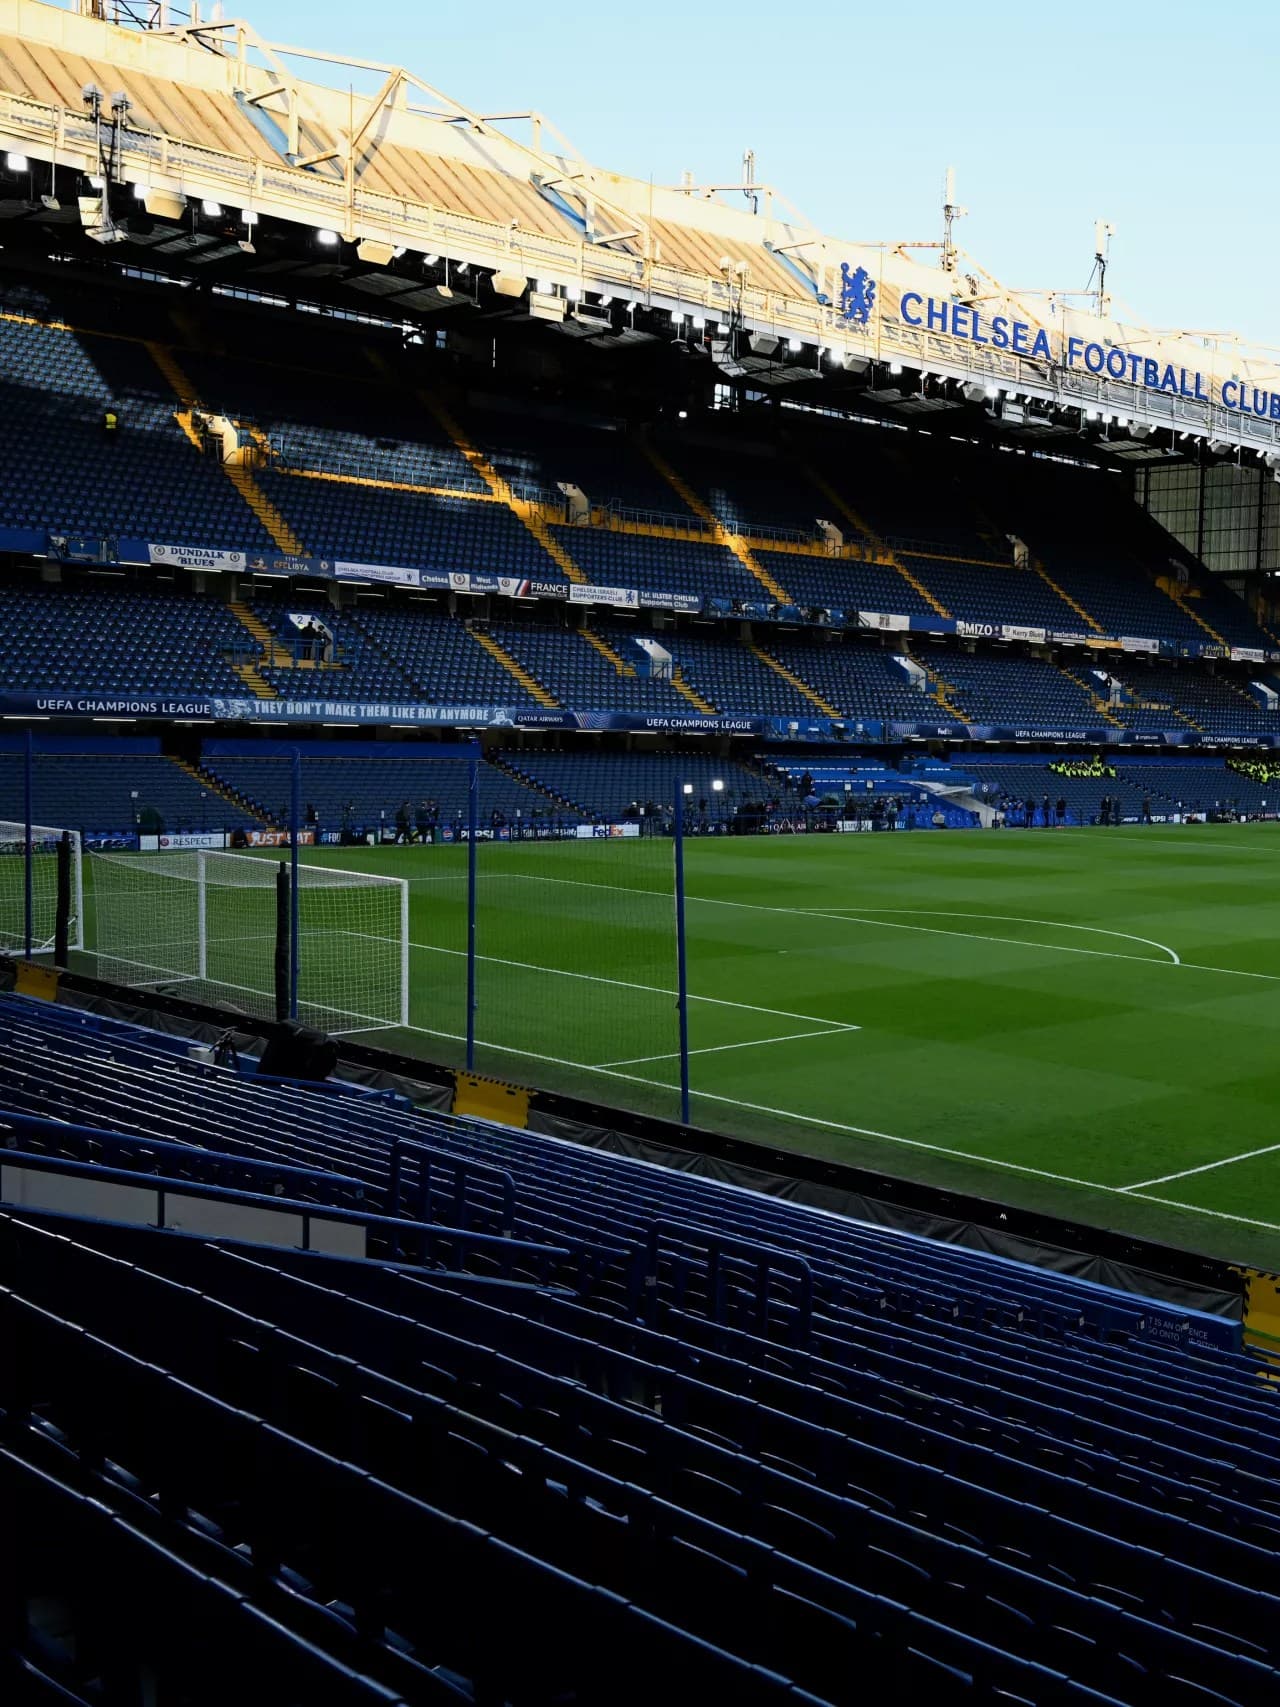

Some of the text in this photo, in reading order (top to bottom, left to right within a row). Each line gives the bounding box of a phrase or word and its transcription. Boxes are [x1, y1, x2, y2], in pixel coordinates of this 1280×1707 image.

[900, 292, 1051, 360] CHELSEA
[1067, 337, 1208, 401] FOOTBALL
[171, 547, 224, 560] DUNDALK
[180, 557, 215, 567] BLUES
[422, 575, 448, 584] Chelsea
[531, 582, 568, 593] FRANCE
[573, 591, 606, 600] SUPPORTERS
[652, 592, 672, 600] ULSTER
[673, 594, 699, 603] CHELSEA
[674, 600, 688, 608] Club
[297, 615, 303, 624] 2
[965, 623, 993, 636] MIZO
[36, 698, 210, 715] UEFA CHAMPIONS LEAGUE
[254, 700, 488, 721] THEY DON'T MAKE THEM LIKE RAY ANYMORE
[646, 718, 751, 729] UEFA CHAMPIONS LEAGUE
[1015, 730, 1030, 738] UEFA
[1031, 731, 1064, 739] CHAMPIONS
[1214, 736, 1240, 744] CHAMPIONS
[592, 826, 624, 837] FedEx
[173, 837, 212, 846] RESPECT
[249, 831, 283, 846] JUST
